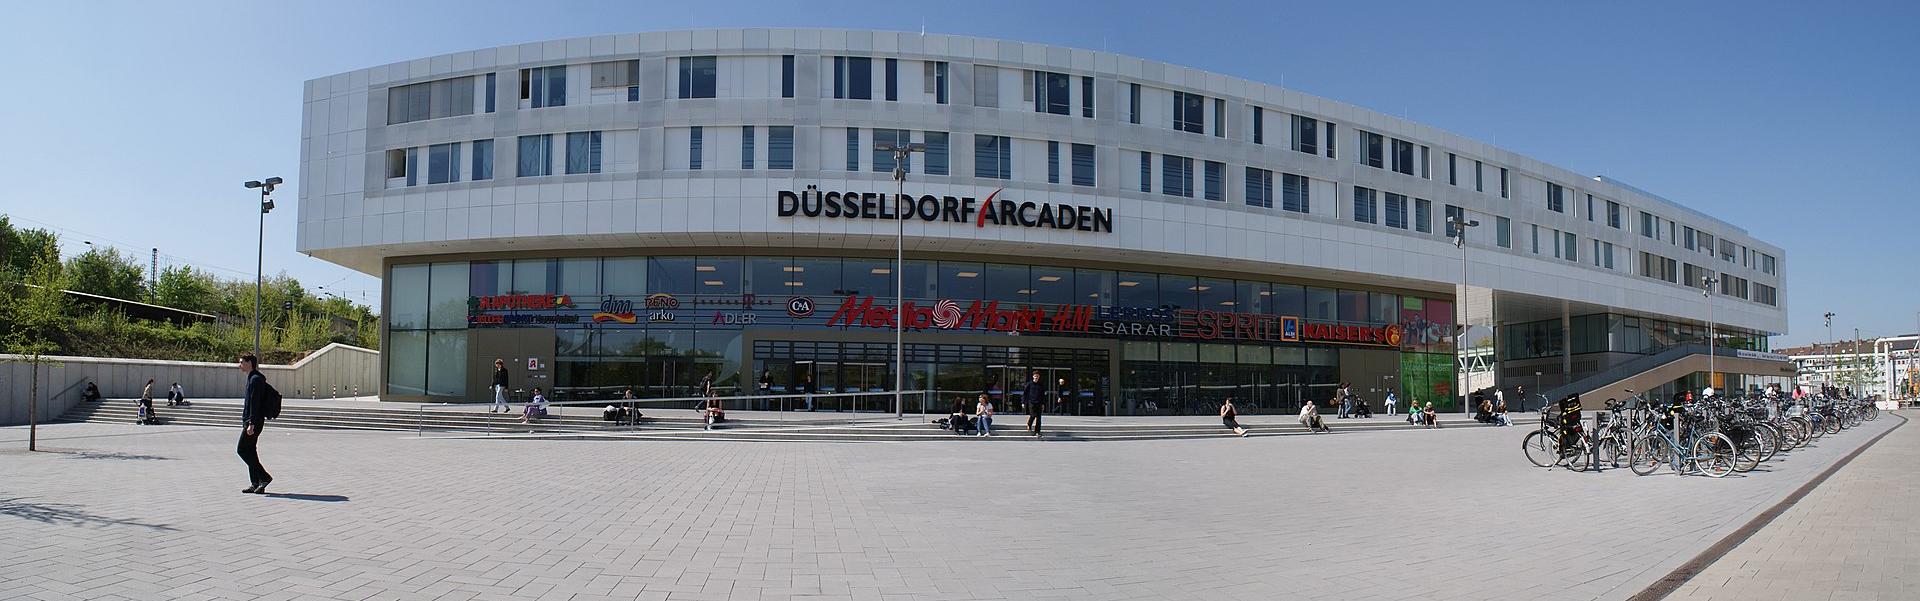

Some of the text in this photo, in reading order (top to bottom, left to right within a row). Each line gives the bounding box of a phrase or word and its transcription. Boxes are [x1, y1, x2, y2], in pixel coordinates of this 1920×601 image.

[777, 184, 1113, 233] DÜSSELDORF ARCADEN
[600, 294, 633, 314] dm
[644, 297, 679, 308] RENO
[790, 301, 811, 311] C&A
[648, 309, 675, 321] arko
[712, 311, 758, 325] ADLER
[826, 295, 1045, 333] Media Markt
[1102, 321, 1171, 337] SARAR
[1178, 309, 1276, 340] ESPRIT
[1302, 322, 1385, 343] KAISER'S
